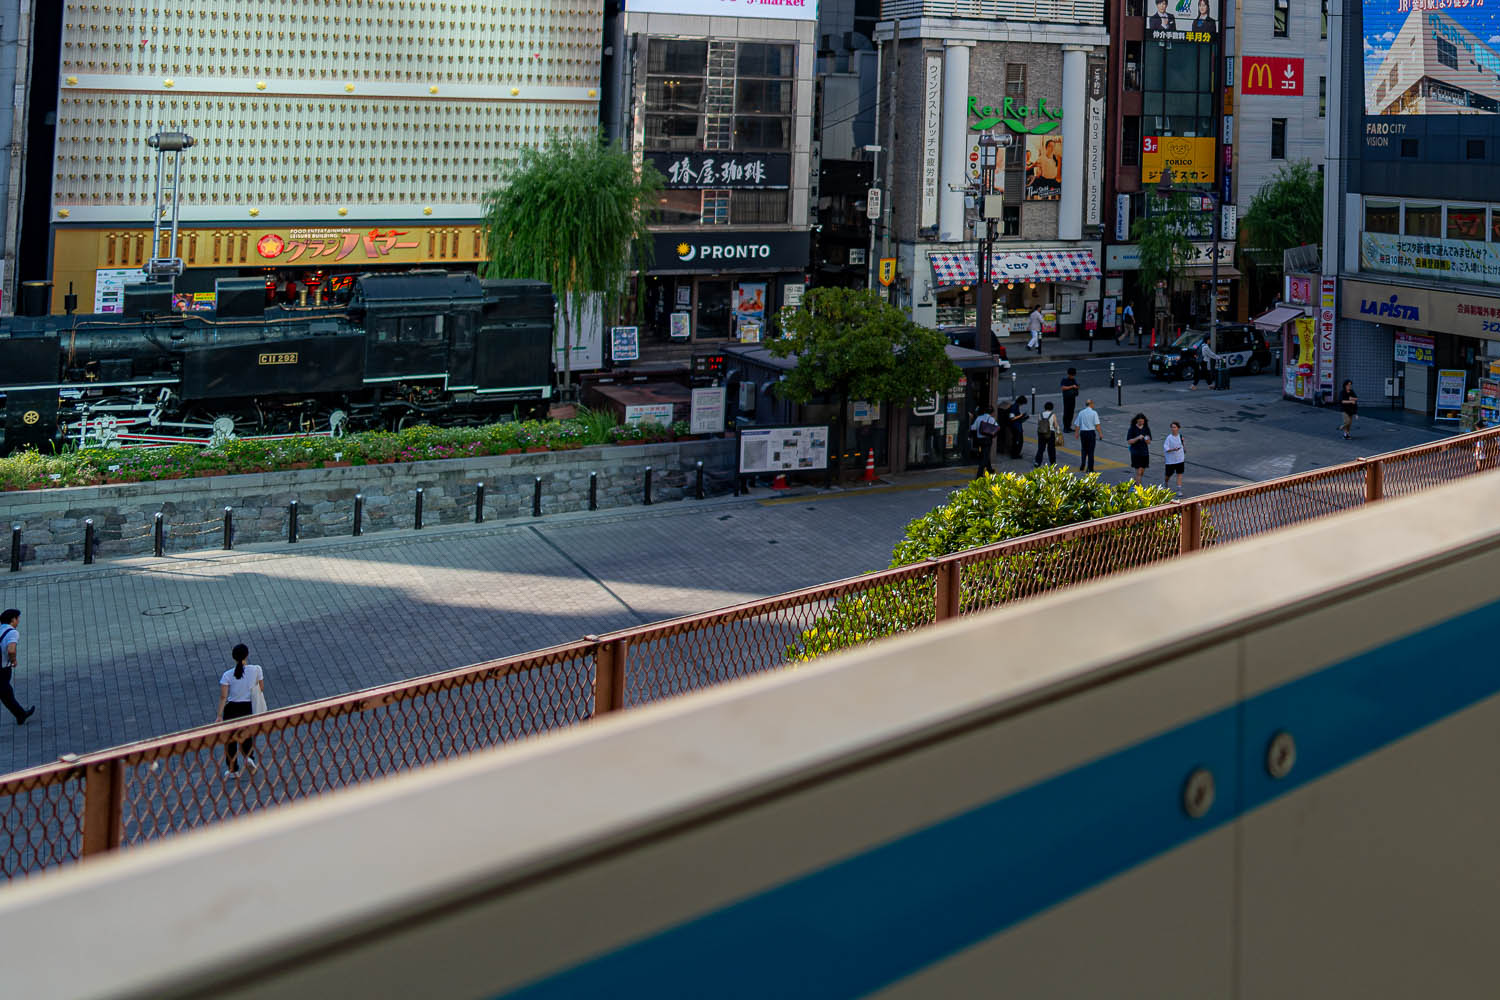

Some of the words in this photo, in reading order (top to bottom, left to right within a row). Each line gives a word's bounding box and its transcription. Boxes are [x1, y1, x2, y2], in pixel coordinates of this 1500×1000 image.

[1366, 124, 1389, 135] FARO
[1390, 124, 1407, 134] CITY
[1144, 138, 1157, 151] 3F
[1367, 137, 1389, 147] VISION
[700, 245, 770, 259] PRONTO
[1005, 262, 1029, 271] ヒロタ
[1360, 300, 1377, 314] LA
